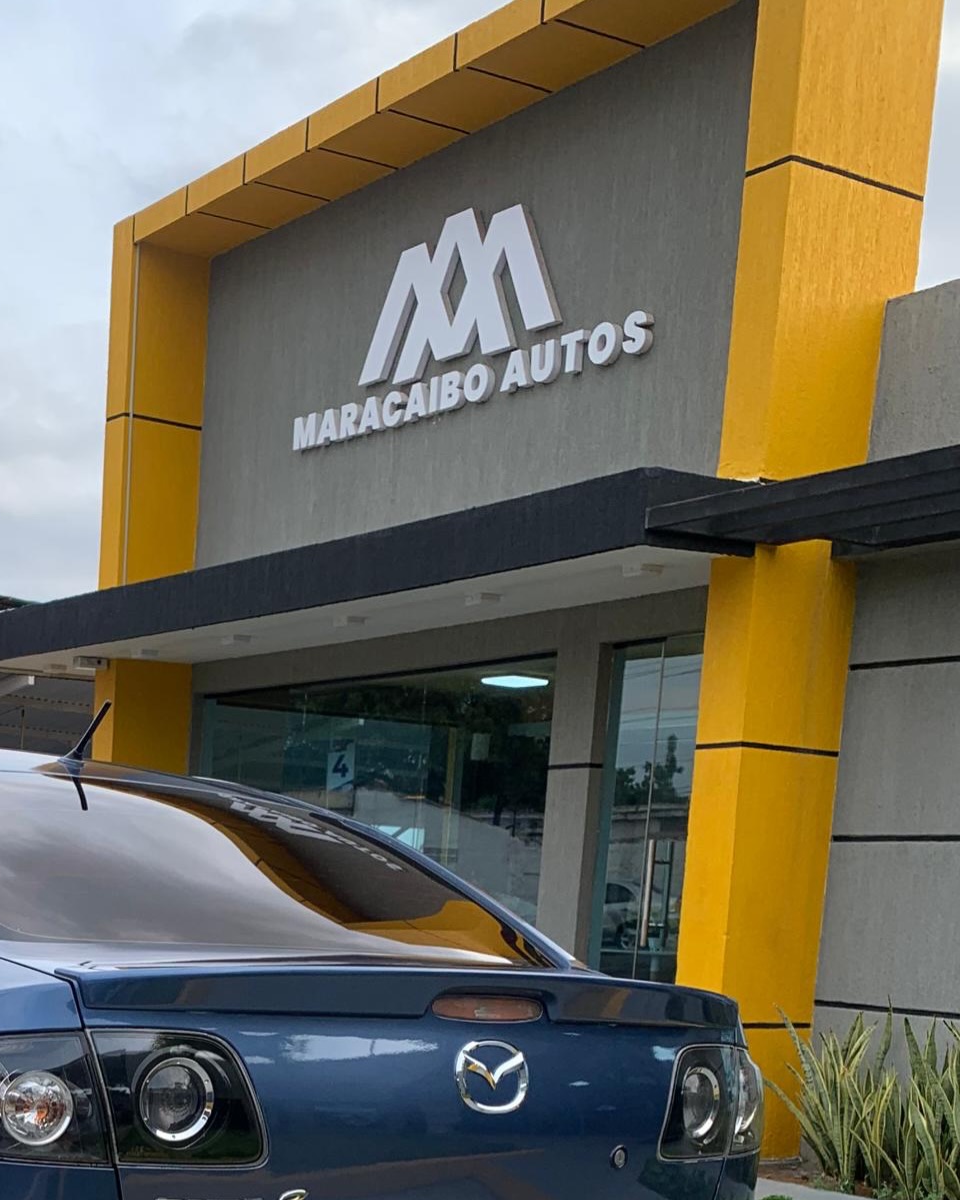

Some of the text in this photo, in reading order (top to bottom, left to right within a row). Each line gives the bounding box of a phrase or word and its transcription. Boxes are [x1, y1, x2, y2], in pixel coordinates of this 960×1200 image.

[293, 310, 655, 451] MARACAIBO AUTOS
[332, 754, 349, 778] 4
